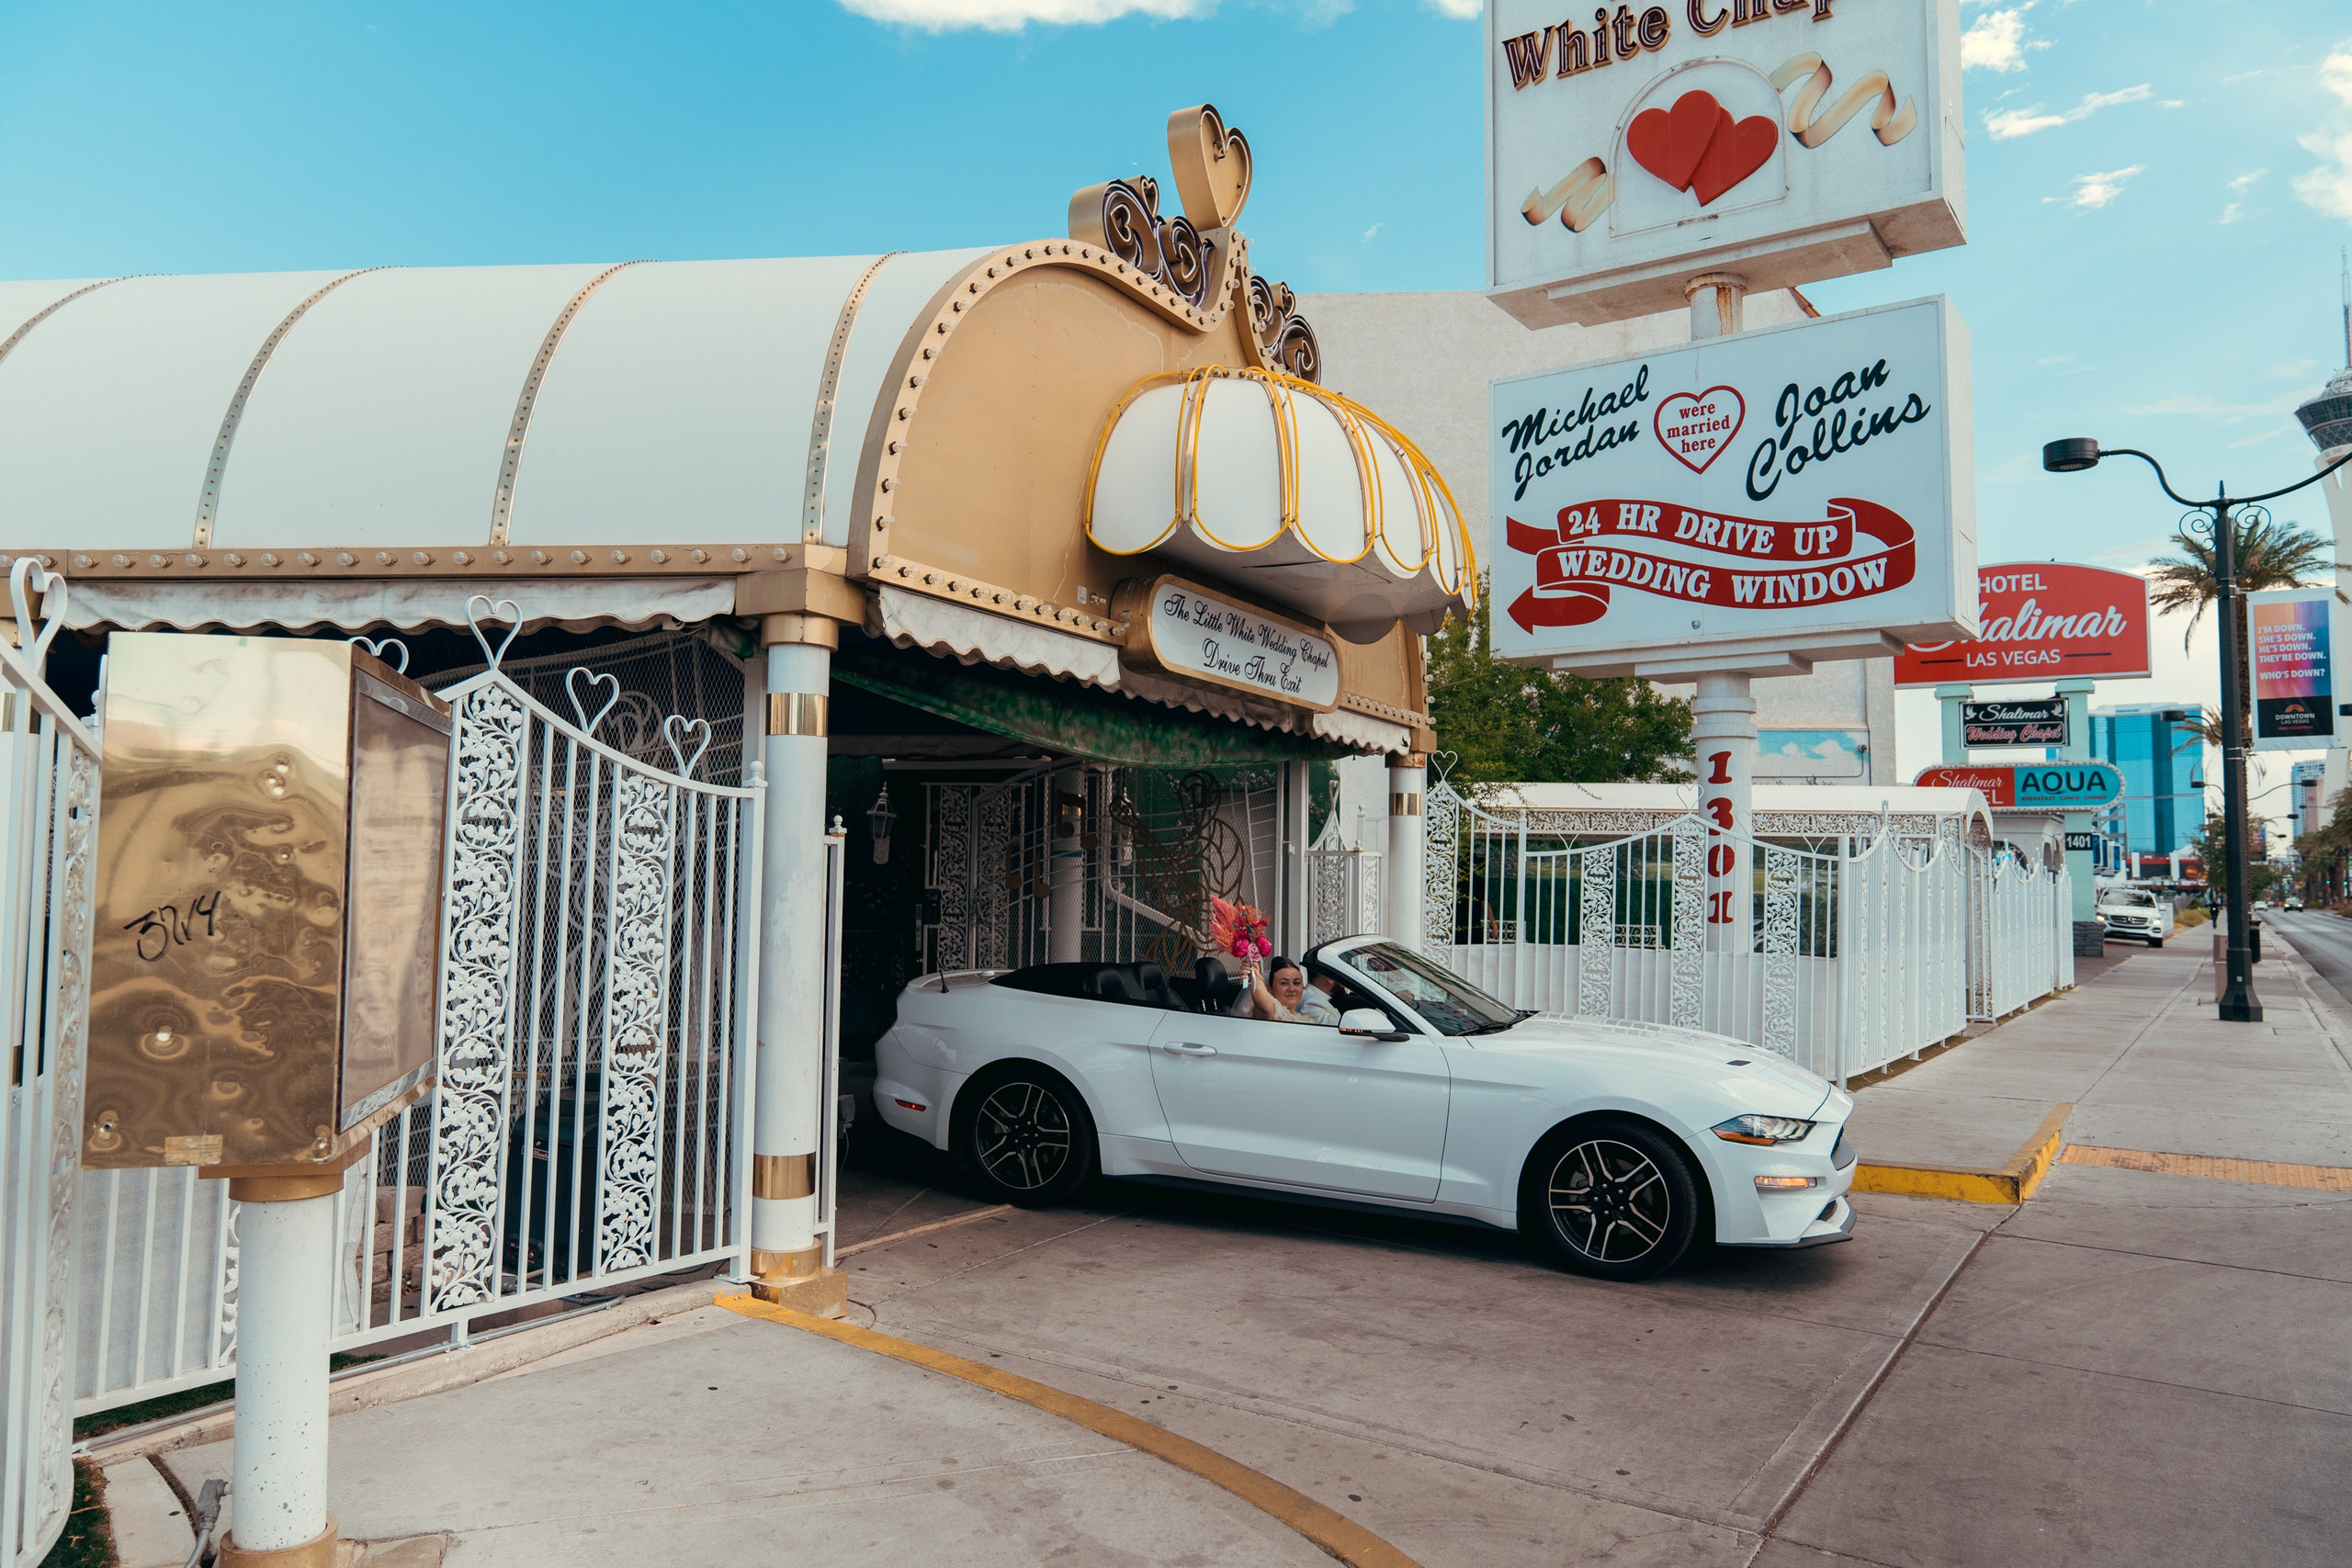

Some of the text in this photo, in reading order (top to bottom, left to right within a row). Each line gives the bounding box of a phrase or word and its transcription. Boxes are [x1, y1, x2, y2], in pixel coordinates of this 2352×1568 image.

[1502, 5, 1670, 90] White
[1502, 364, 1650, 454] Michael
[1679, 401, 1716, 420] were
[1776, 358, 1890, 451] Joan
[1666, 414, 1731, 439] married
[1680, 434, 1716, 453] here
[1747, 392, 1931, 502] Collins
[1514, 420, 1640, 502] Jordan
[1567, 503, 1839, 555] 24 HR DRIVE UP
[1556, 550, 1888, 605] WEDDING WINDOW
[1977, 572, 2048, 593] HOTEL
[1163, 593, 1330, 671] The Little White Wedding Chapel
[1906, 597, 2128, 653] halimar
[2258, 623, 2306, 634] I'M DOWN.
[2258, 632, 2317, 644] SHE'S DOWN.
[2259, 642, 2312, 653] HE'S DOWN.
[1202, 637, 1303, 694] Drive Thru Exit
[1966, 649, 2062, 667] LAS VEGAS
[2259, 651, 2327, 663] THEY'RE DOWN.
[2260, 668, 2325, 680] WHO'S DOWN?
[1978, 704, 2050, 722] Shalimar
[2275, 713, 2315, 721] DOWNTOWN
[1967, 723, 2062, 744] Wedding Chapel
[1931, 770, 2005, 788] Shalimar
[2021, 771, 2108, 794] AQUA
[2066, 835, 2092, 849] 1401
